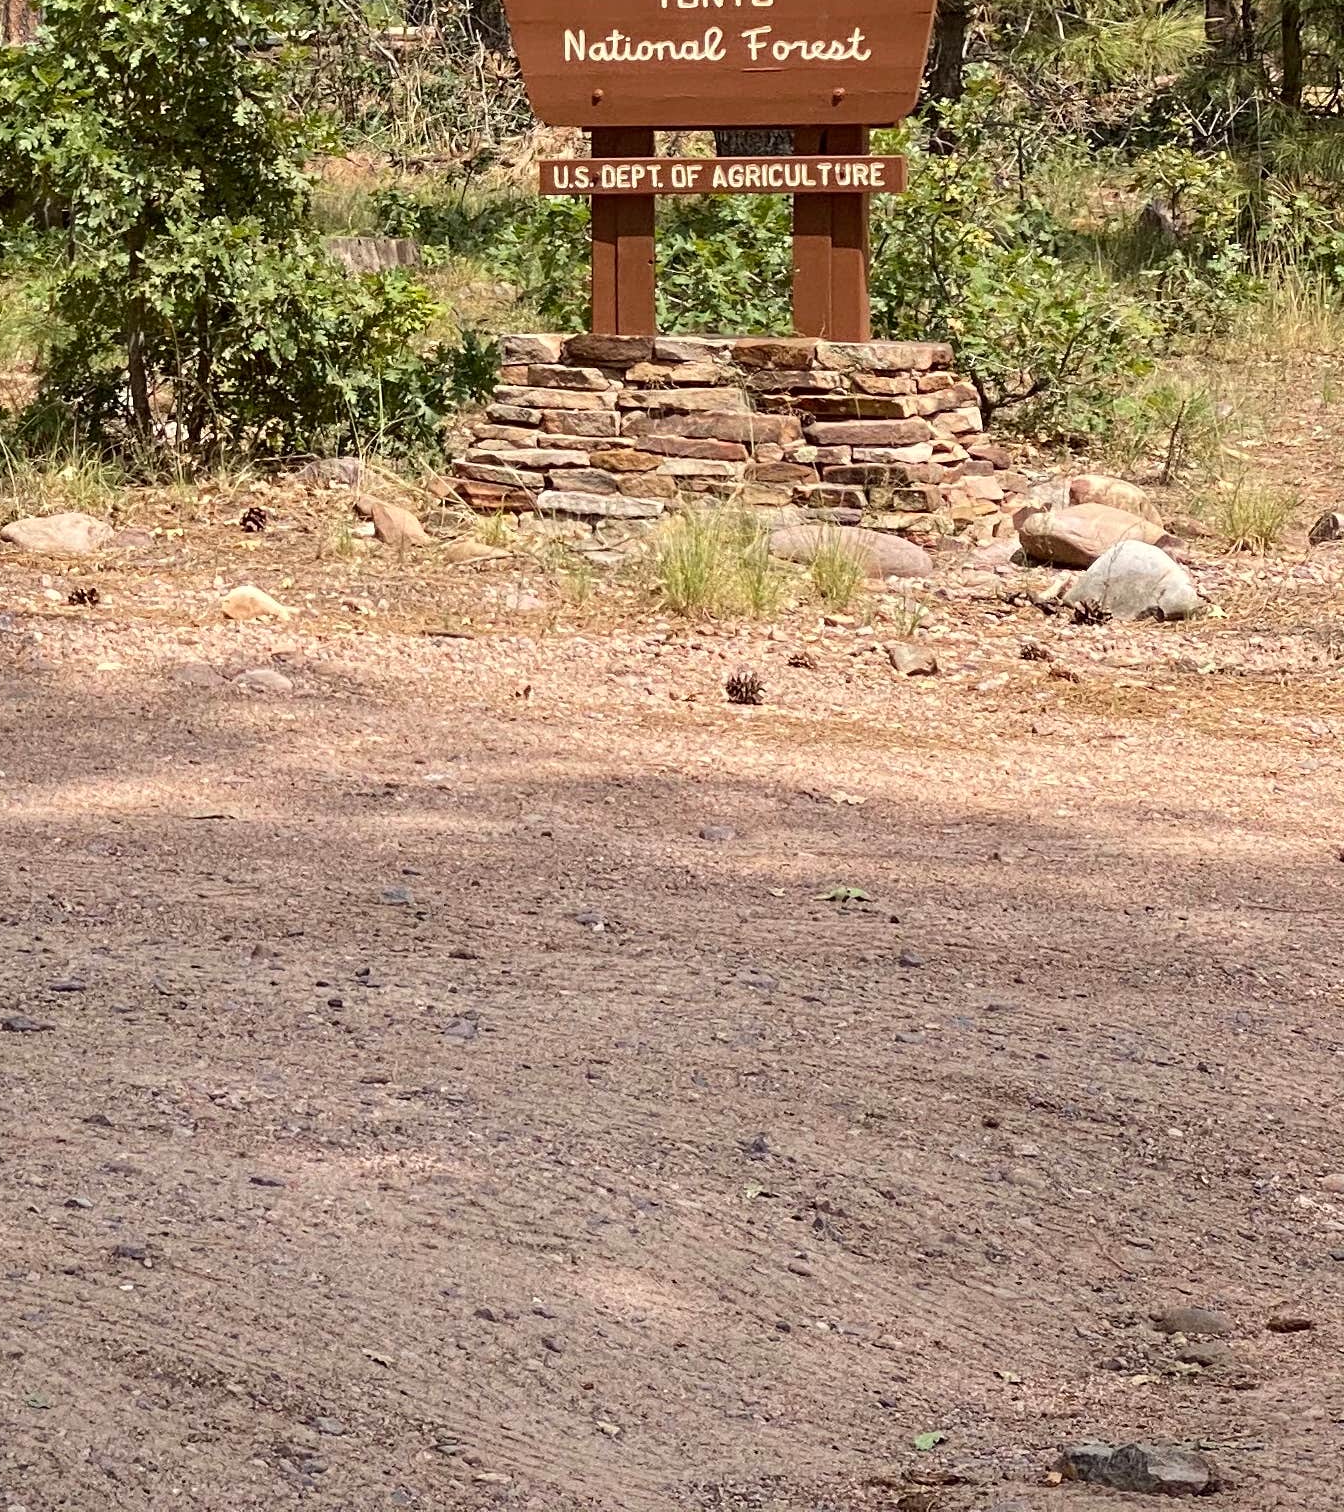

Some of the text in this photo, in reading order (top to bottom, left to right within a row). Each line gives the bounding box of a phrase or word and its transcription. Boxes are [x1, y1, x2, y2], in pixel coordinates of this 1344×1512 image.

[564, 25, 873, 63] National Forest
[553, 162, 886, 189] U.S. DEPT. OF AGRICULTURE
